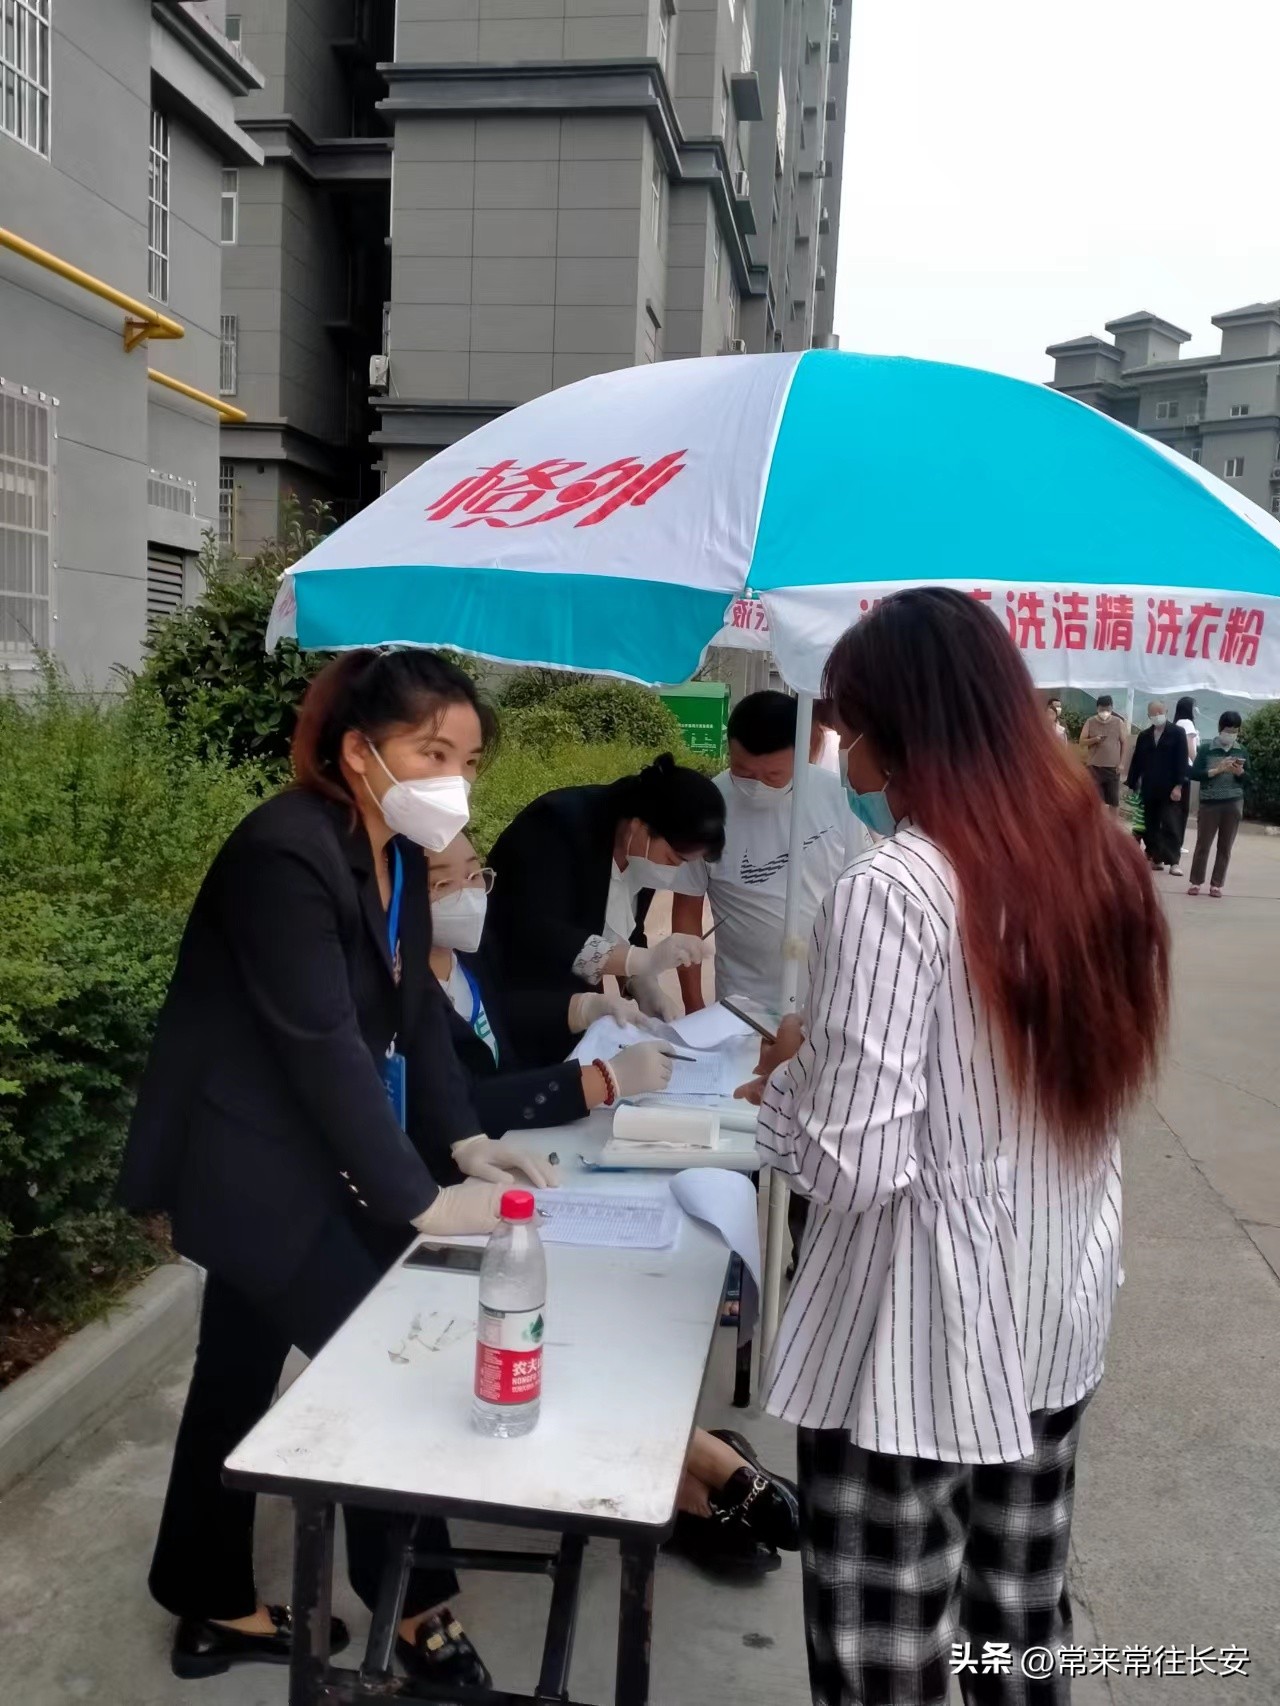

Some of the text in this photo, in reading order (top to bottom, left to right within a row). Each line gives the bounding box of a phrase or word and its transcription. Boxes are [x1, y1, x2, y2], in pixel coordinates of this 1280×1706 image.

[1006, 590, 1134, 652] 洗洁精
[1146, 597, 1265, 667] 洗衣粉
